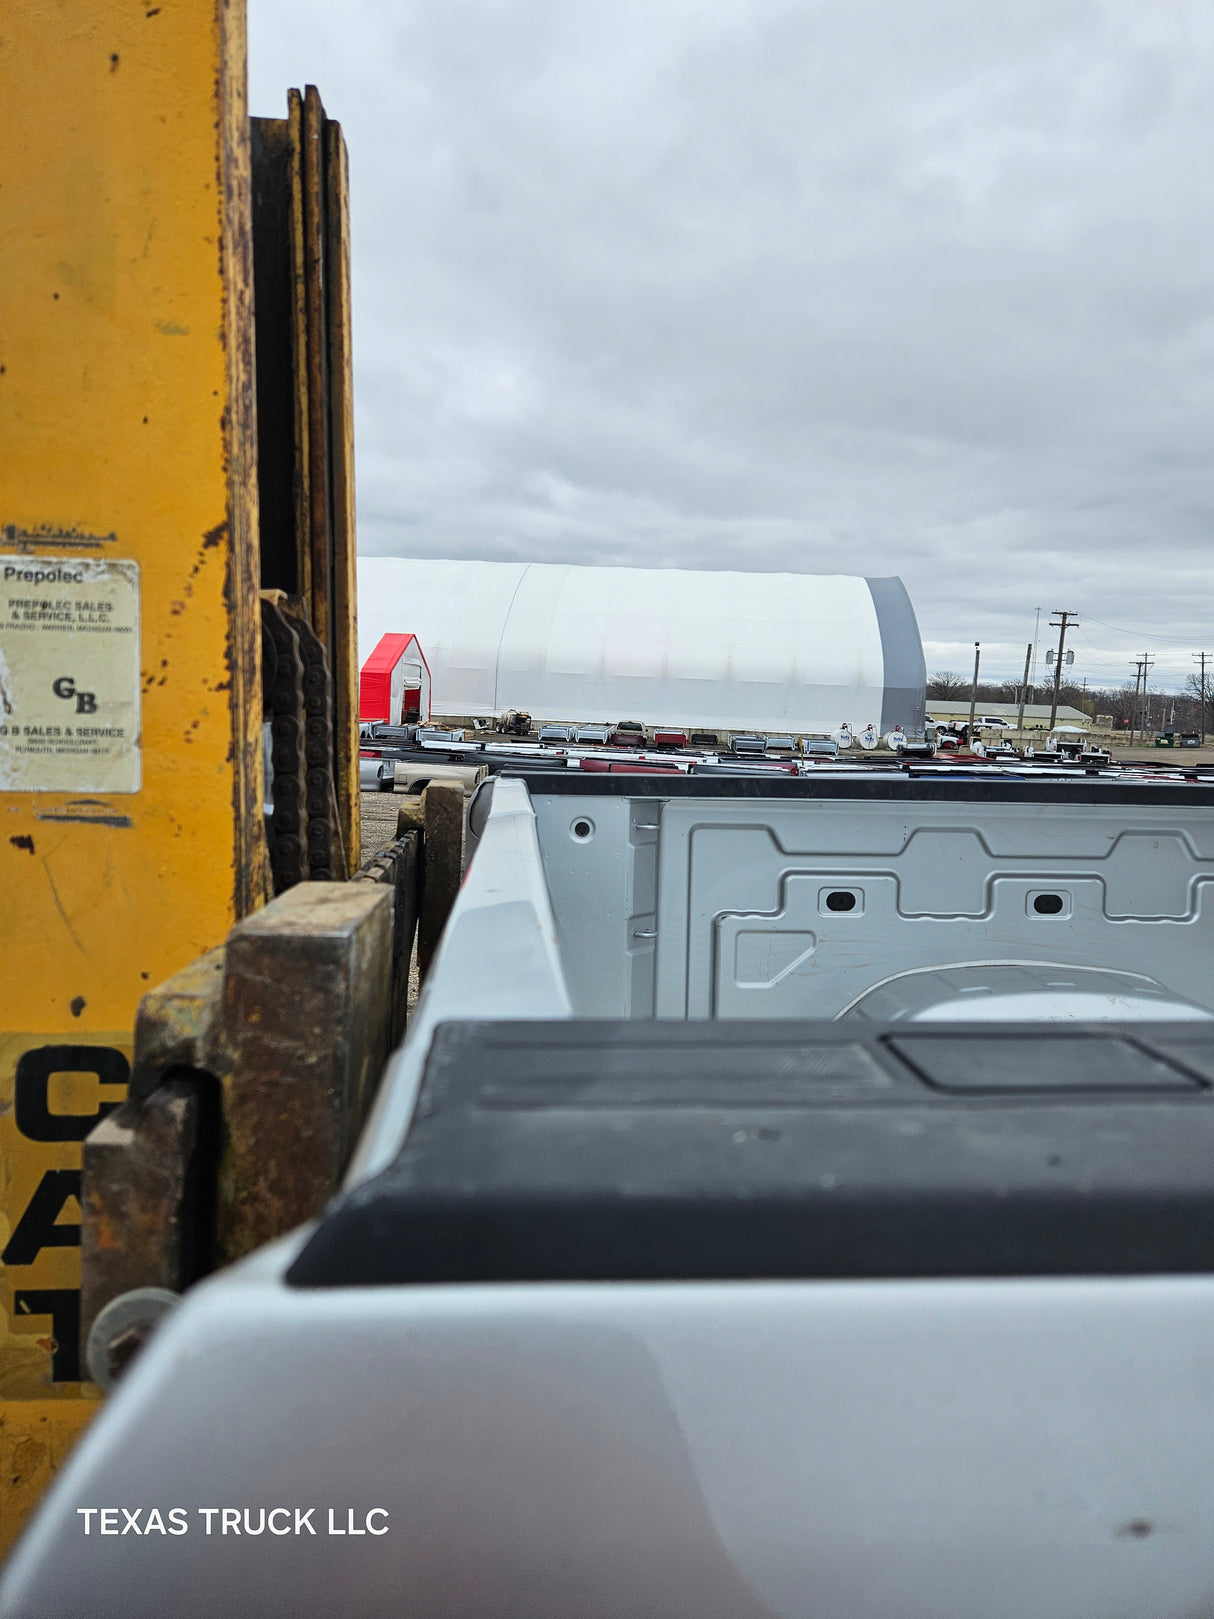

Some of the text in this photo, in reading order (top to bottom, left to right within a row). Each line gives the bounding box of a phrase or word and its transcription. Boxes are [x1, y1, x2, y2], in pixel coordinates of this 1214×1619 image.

[3, 566, 83, 586] Prepolec
[8, 599, 113, 612] PREPOLEC SALES
[11, 610, 111, 623] & SERVICE, L.L.C.
[11, 726, 19, 736] B
[23, 726, 61, 737] SALES
[65, 726, 73, 737] &
[75, 727, 126, 738] SERVICE
[1, 1045, 131, 1382] CAT
